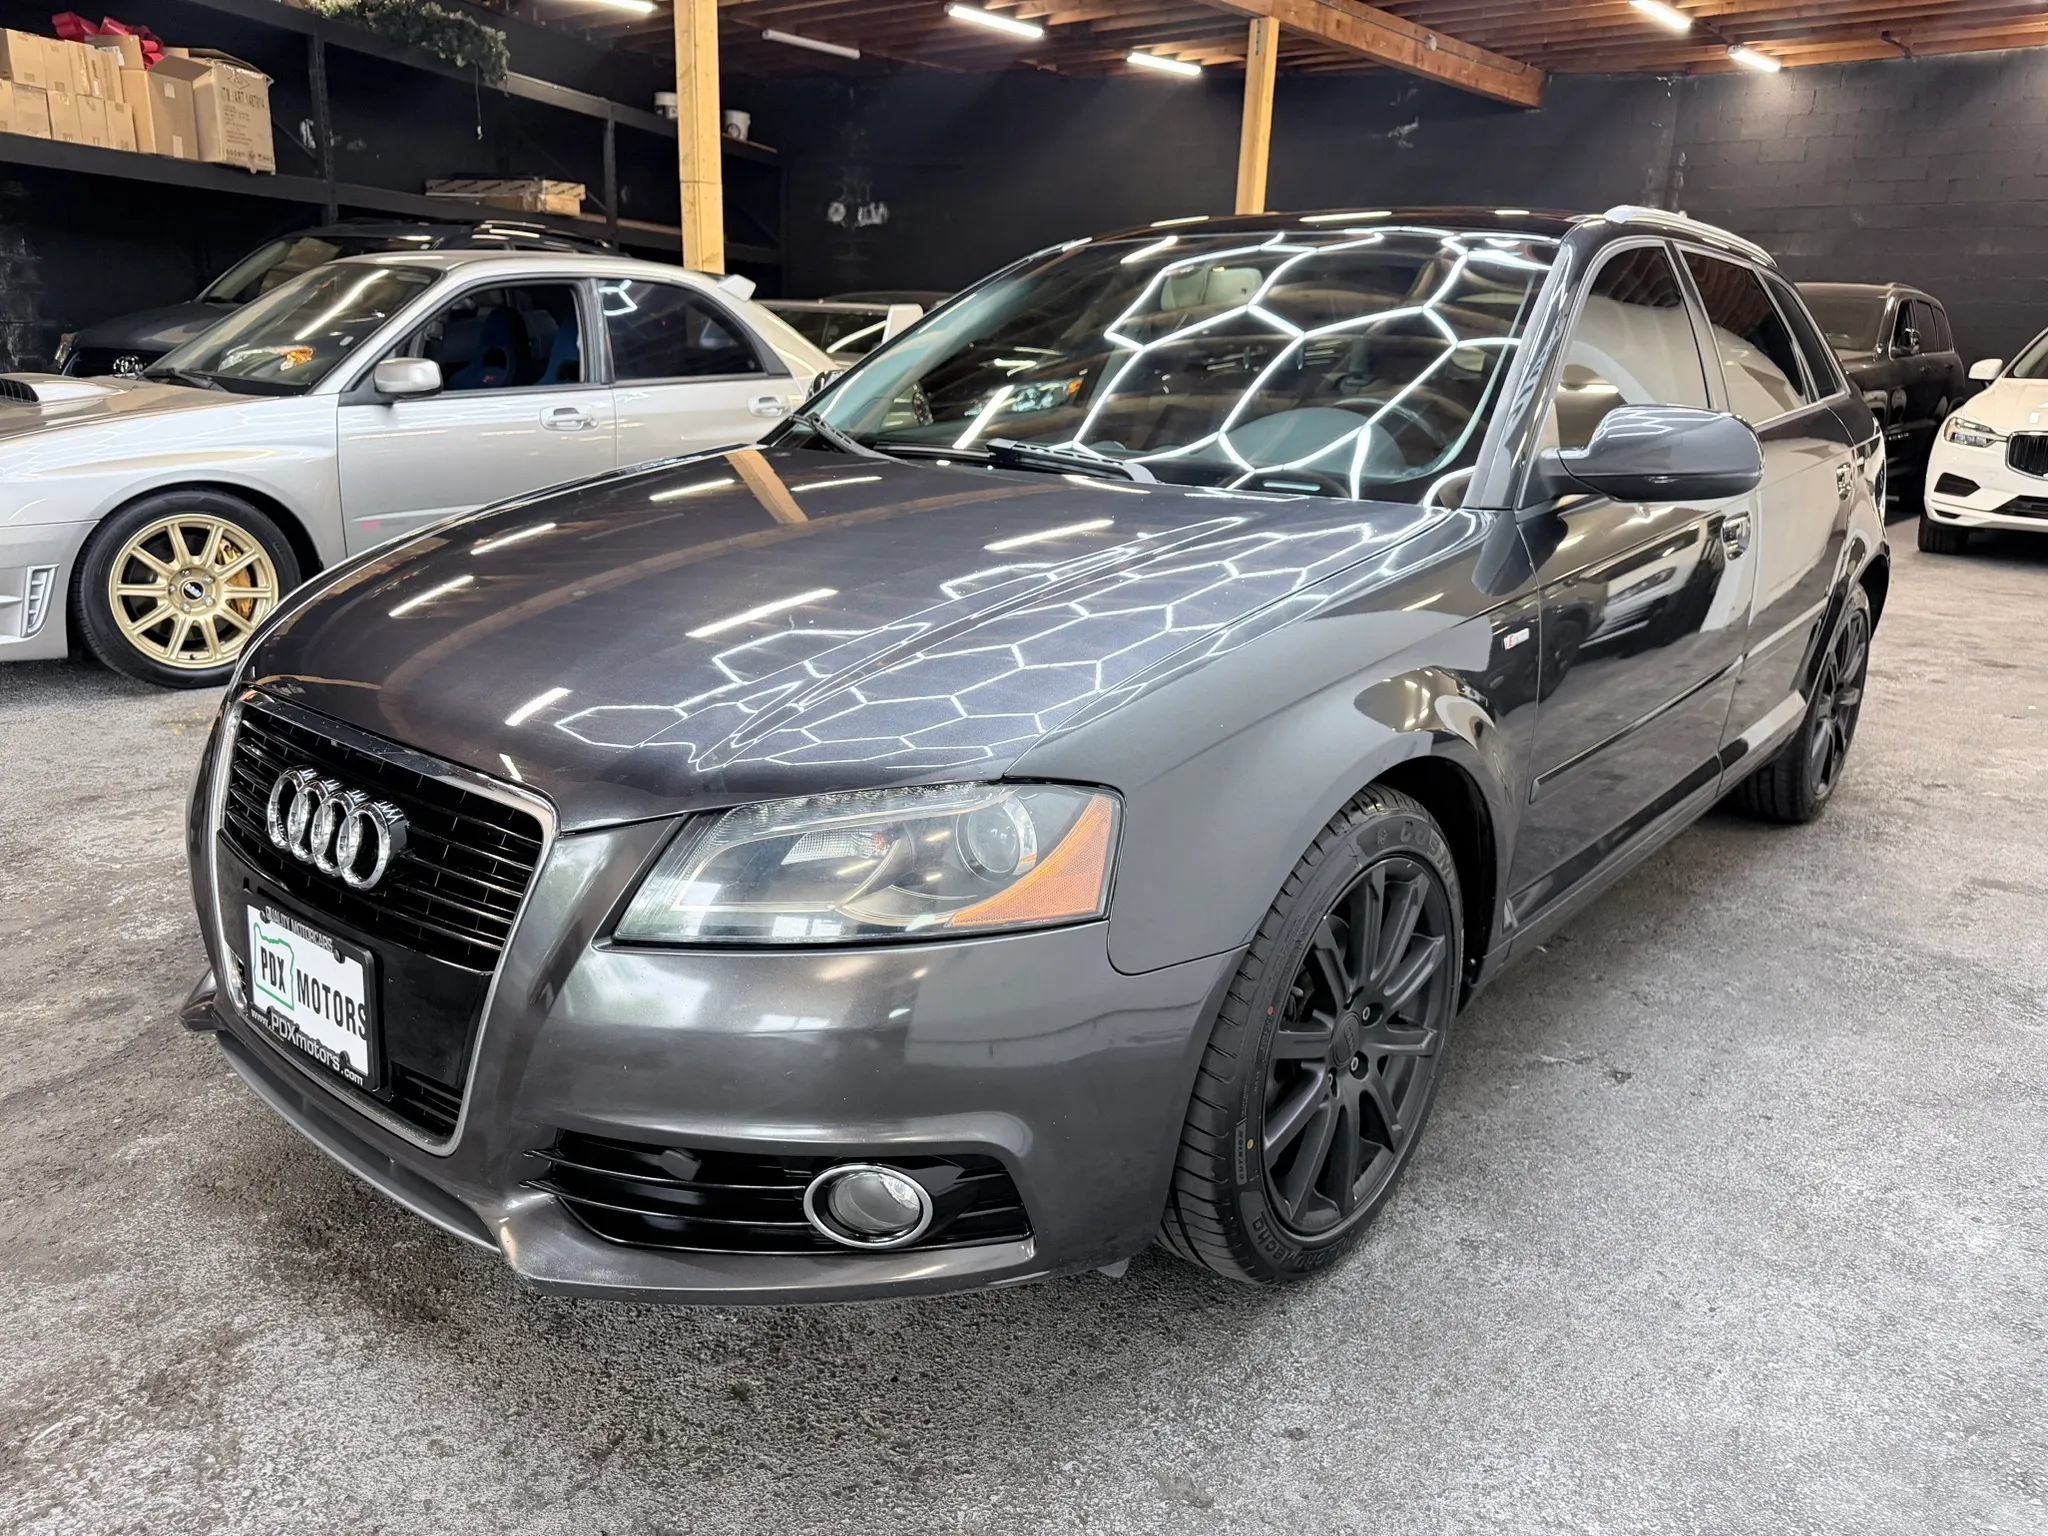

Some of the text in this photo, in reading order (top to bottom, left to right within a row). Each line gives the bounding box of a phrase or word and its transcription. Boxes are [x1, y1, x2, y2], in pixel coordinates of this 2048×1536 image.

[264, 905, 333, 951] QUALITY MOTORCARS
[260, 946, 368, 1041] PDX MOTORS
[250, 1009, 364, 1086] www.PDXmotors.com
